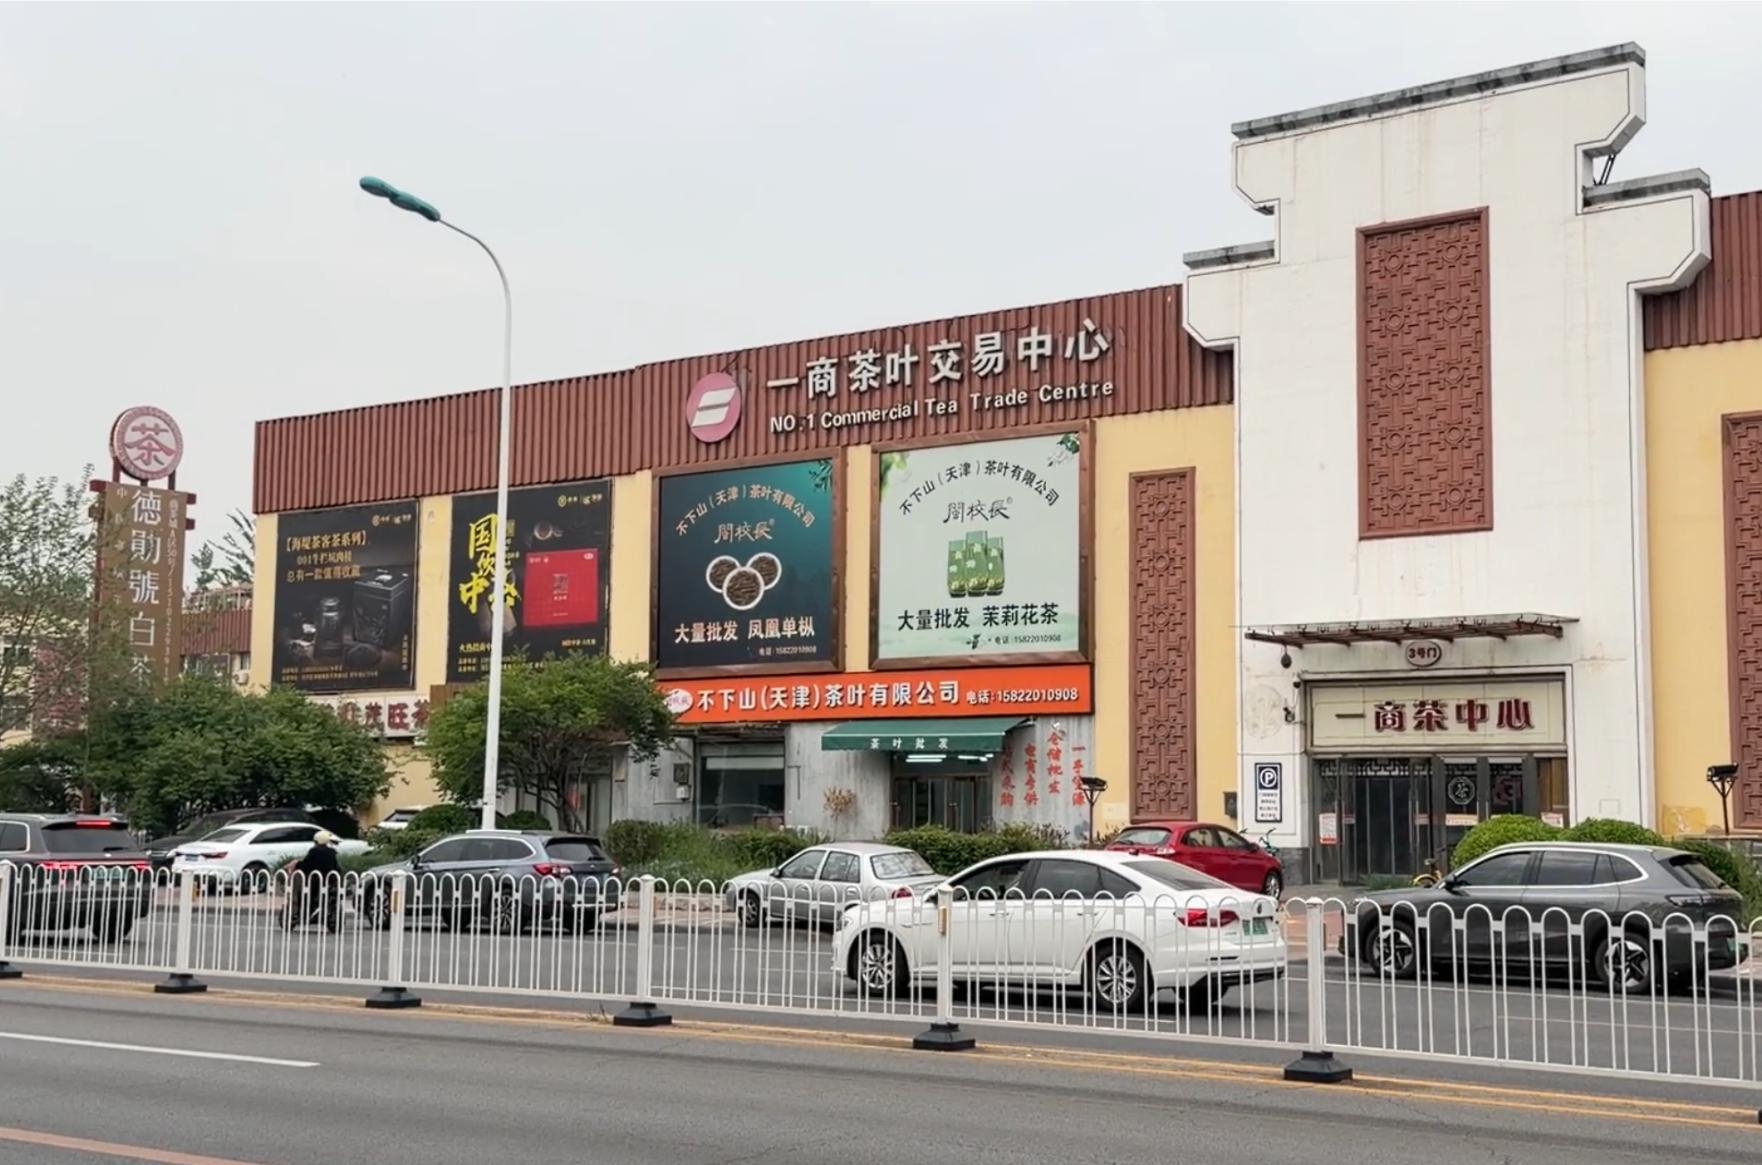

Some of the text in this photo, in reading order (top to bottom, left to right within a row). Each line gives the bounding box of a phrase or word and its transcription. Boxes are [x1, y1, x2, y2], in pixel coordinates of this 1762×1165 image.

[766, 317, 1111, 400] 一商茶叶交易中心
[820, 399, 919, 428] Commercial
[925, 397, 958, 415] Tea
[970, 388, 1028, 411] Trade
[1038, 381, 1114, 402] Centre
[674, 615, 816, 644] 大量批发 凤凰单枞
[897, 602, 1060, 632] 大量批发 茉莉花茶
[1407, 647, 1437, 660] 3号门
[1334, 698, 1535, 733] 一商茶中心
